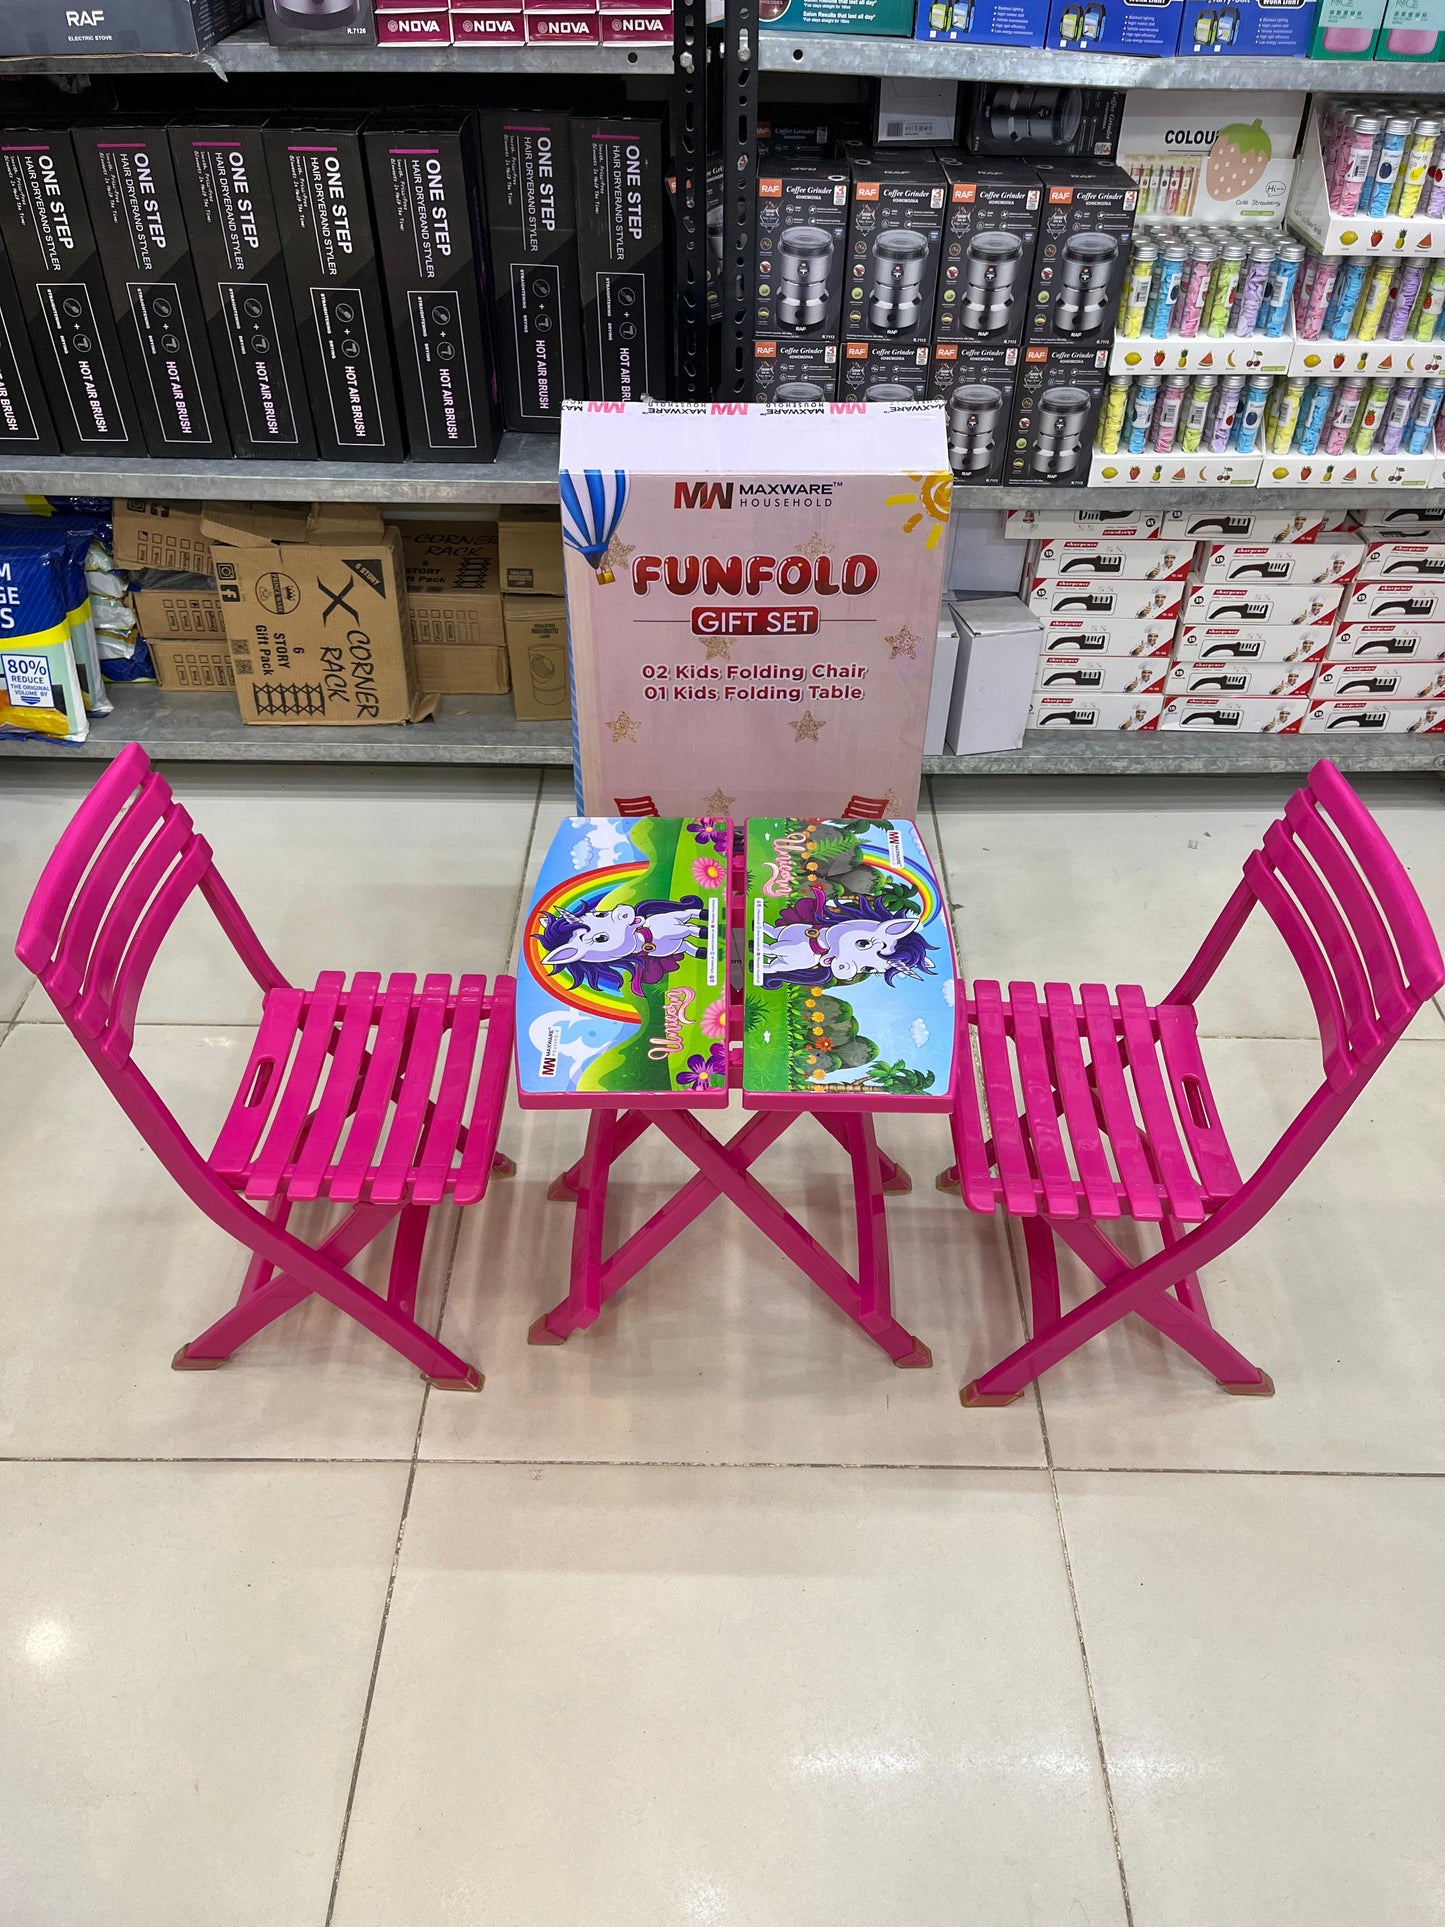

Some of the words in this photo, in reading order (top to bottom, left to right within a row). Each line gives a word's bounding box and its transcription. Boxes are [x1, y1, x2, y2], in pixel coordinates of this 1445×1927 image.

[65, 10, 105, 27] RAF
[399, 20, 440, 32] NOVA
[473, 20, 515, 32] NOVA
[548, 22, 590, 34] NOVA
[622, 19, 664, 31] NOVA
[1164, 129, 1219, 145] COLOU
[215, 152, 226, 176] HAIR
[538, 137, 552, 178] ONE
[612, 145, 621, 169] HAIR
[626, 146, 640, 186] ONE
[135, 153, 155, 194] ONE
[229, 152, 249, 194] ONE
[325, 157, 344, 199] ONE
[412, 160, 422, 183] HAIR
[426, 159, 444, 201] ONE
[614, 171, 622, 223] DRYERAND
[807, 186, 832, 194] Grinder
[884, 189, 903, 197] Coffee
[904, 190, 929, 198] Grinder
[980, 191, 1000, 199] Coffee
[1052, 192, 1070, 200] RAF
[25, 156, 37, 179] HAIR
[31, 182, 50, 233] DRYERAND
[46, 236, 61, 271] STYLER
[39, 156, 61, 196] ONE
[50, 202, 74, 249] STEP
[220, 178, 236, 232] DRYERAND
[415, 186, 430, 240] DRYERAND
[540, 184, 555, 231] STEP
[144, 200, 166, 248] STEP
[238, 200, 258, 248] STEP
[627, 192, 642, 240] STEP
[332, 205, 352, 254] STEP
[432, 207, 451, 256] STEP
[231, 234, 244, 270] STYLER
[615, 226, 624, 260] STYLER
[423, 242, 434, 278] STYLER
[536, 340, 546, 359] HOT
[620, 348, 629, 367] HOT
[800, 347, 823, 355] Grinder
[78, 361, 92, 380] HOT
[256, 362, 268, 382] HOT
[439, 368, 451, 389] HOT
[537, 361, 547, 377] AIR
[620, 369, 630, 384] AIR
[0, 382, 8, 397] AIR
[85, 382, 97, 399] AIR
[260, 383, 271, 399] AIR
[442, 390, 453, 406] AIR
[538, 378, 549, 409] BRUSH
[1, 399, 19, 431] BRUSH
[90, 400, 108, 432] BRUSH
[263, 402, 278, 434] BRUSH
[444, 408, 458, 439] BRUSH
[740, 498, 833, 507] HOUSEHOLD
[425, 546, 485, 557] RACK
[359, 567, 380, 585] STORY
[632, 554, 879, 596] FUNFOLD
[697, 611, 758, 633] GIFT
[766, 610, 814, 632] SET
[255, 624, 269, 645] Gift
[260, 648, 274, 676] Pack
[273, 632, 291, 669] STORY
[7, 659, 47, 676] 80%
[319, 646, 351, 703] RACK
[346, 630, 380, 719] CORNER
[642, 665, 669, 679] 02
[675, 664, 720, 679] Kids
[726, 664, 804, 681] Folding
[811, 663, 867, 679] Chair
[11, 675, 45, 684] REDUCE
[644, 686, 667, 700] 01
[673, 685, 717, 700] Kids
[724, 685, 801, 702] Folding
[808, 685, 863, 699] Table
